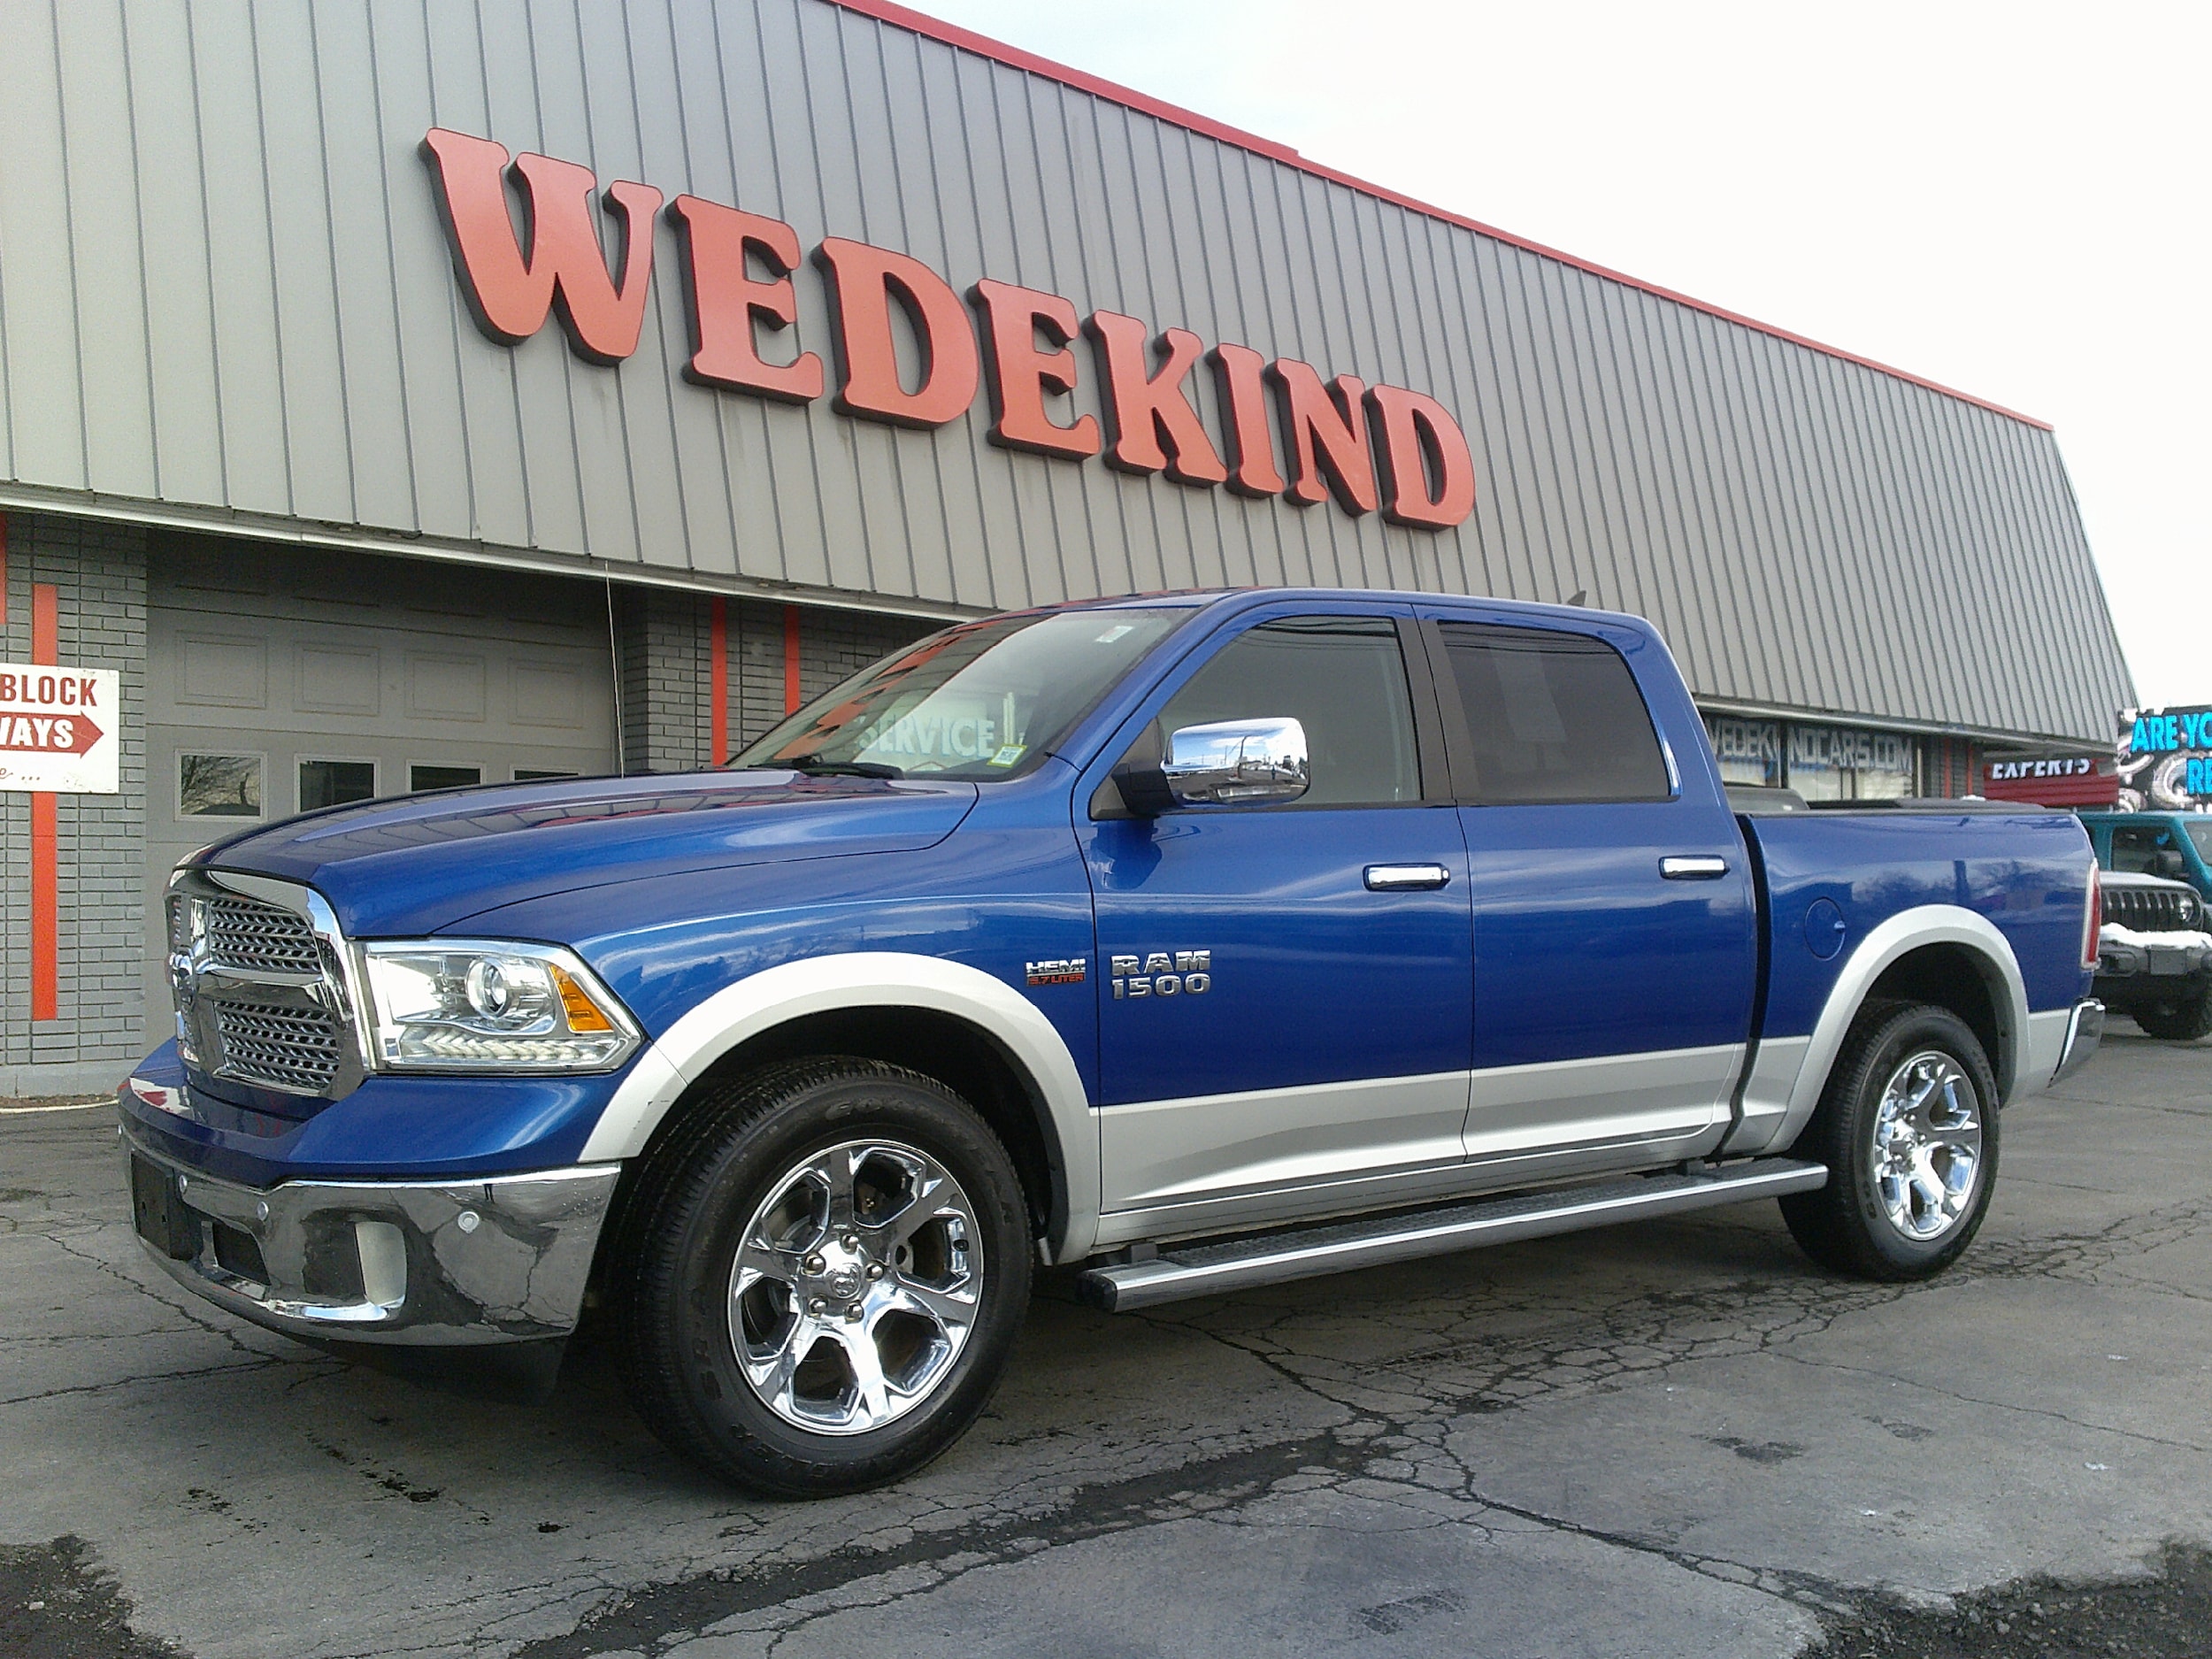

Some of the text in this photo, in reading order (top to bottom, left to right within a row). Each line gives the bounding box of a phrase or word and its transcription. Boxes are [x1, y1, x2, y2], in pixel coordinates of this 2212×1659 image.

[419, 127, 1476, 528] WEDEKIND
[0, 673, 97, 707] BLOCK
[854, 715, 995, 758] SERVICE
[2131, 715, 2179, 752] ARE
[1025, 958, 1087, 974] HEMI
[1111, 949, 1211, 976] RAM
[1050, 973, 1085, 984] LITER
[1111, 972, 1211, 1000] 1500
